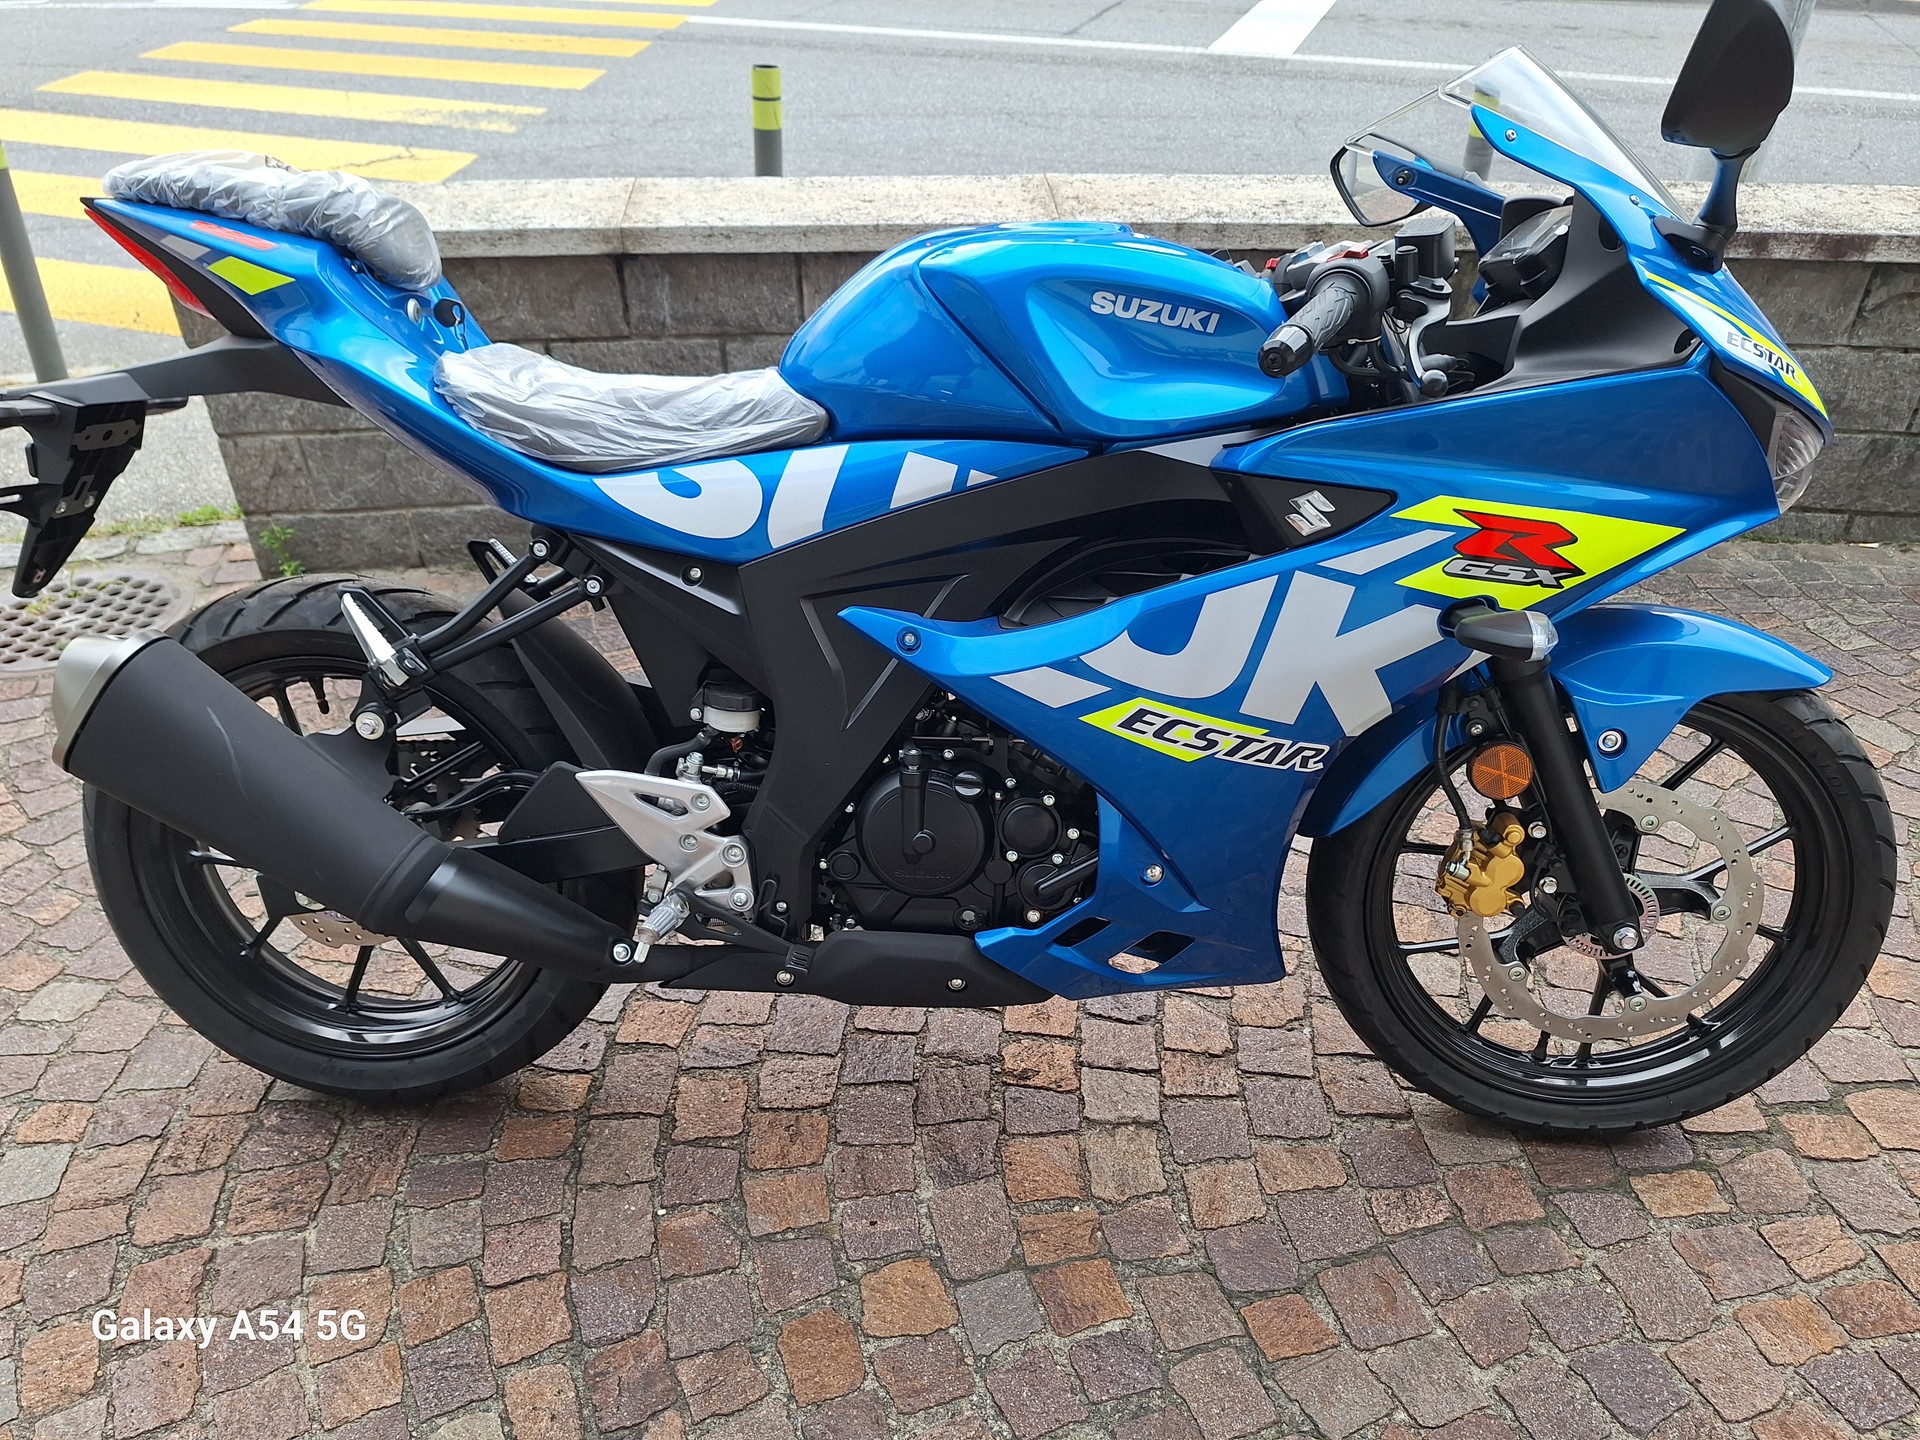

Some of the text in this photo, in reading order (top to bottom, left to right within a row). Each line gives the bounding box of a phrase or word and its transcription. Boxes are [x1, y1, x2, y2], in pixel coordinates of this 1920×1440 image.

[1090, 291, 1221, 334] SUZUKI
[1726, 331, 1801, 384] ECSTAR
[1443, 558, 1573, 587] GSX
[1114, 706, 1329, 771] ECSTAR
